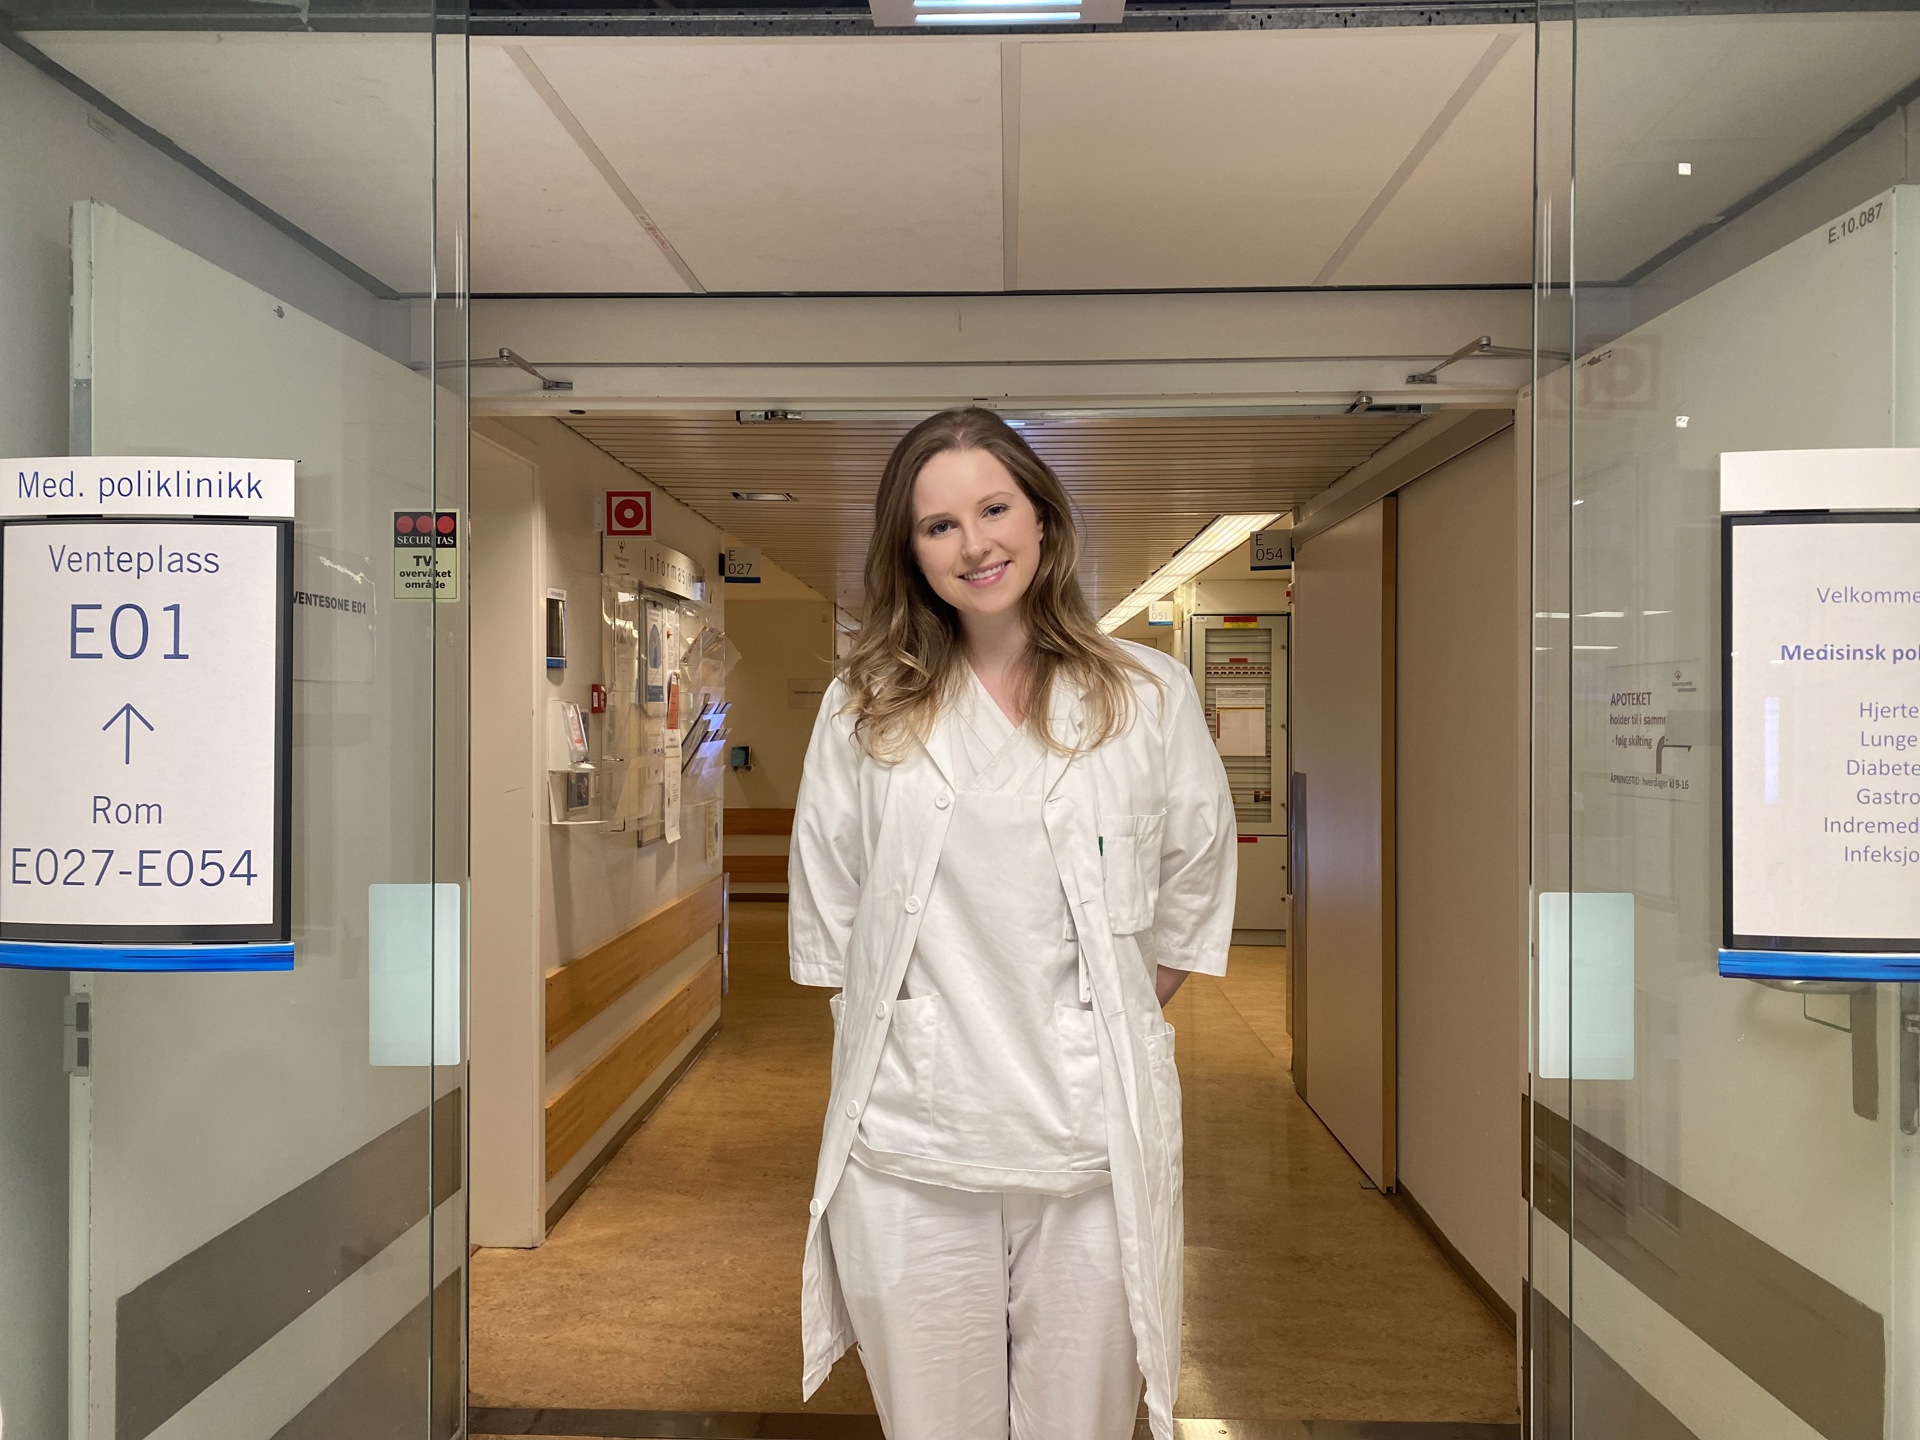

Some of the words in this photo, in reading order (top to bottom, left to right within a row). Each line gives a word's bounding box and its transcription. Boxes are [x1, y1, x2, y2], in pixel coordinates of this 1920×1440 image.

[1828, 202, 1883, 244] E.10.087
[18, 471, 84, 498] Med.
[99, 470, 263, 503] poliklinikk
[397, 535, 454, 545] SECURTAS
[1255, 533, 1264, 546] E
[48, 544, 221, 579] Venteplass
[728, 549, 736, 561] E
[1255, 548, 1284, 561] 054
[728, 563, 753, 575] 027
[293, 591, 350, 612] VENTESONE
[351, 600, 366, 615] E01
[69, 603, 190, 660] E01
[1781, 644, 1887, 661] Medisinsk
[1610, 692, 1652, 706] APOTEKET
[1610, 713, 1630, 725] holder
[1631, 713, 1639, 725] til
[1859, 702, 1919, 722] Hjerte
[1615, 734, 1628, 748] følg
[1628, 734, 1653, 750] skilting
[1860, 731, 1918, 751] Lunge
[1642, 777, 1668, 789] hverdager
[1675, 779, 1690, 790] 9-16
[1856, 788, 1920, 805] Gastro
[92, 795, 163, 824] Rom
[1824, 816, 1919, 834] Indremed
[1844, 845, 1920, 867] Infeksjo
[11, 848, 258, 887] E027-E054
